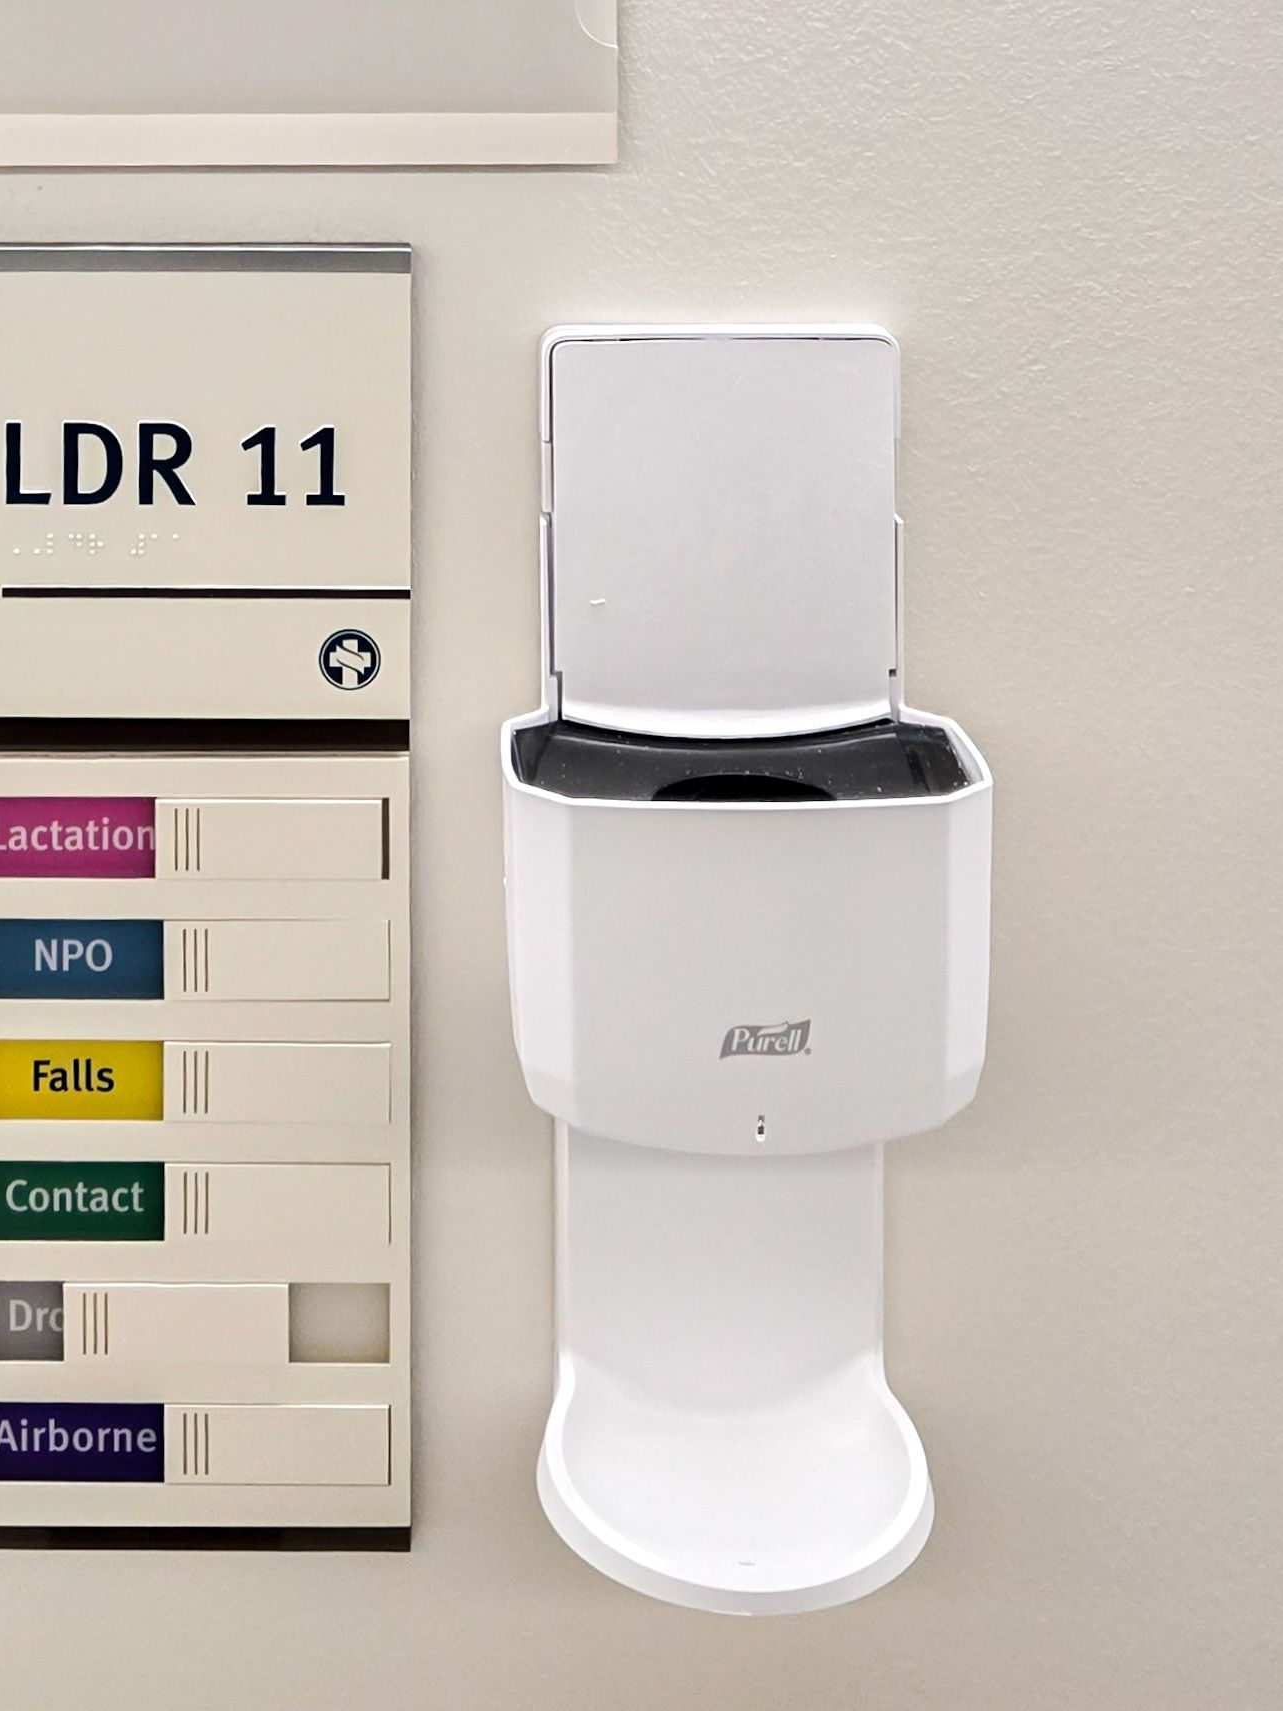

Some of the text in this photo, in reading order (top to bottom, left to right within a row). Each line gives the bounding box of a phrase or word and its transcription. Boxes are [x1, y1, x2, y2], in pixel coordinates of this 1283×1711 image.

[5, 421, 346, 506] LDR 11
[33, 939, 113, 972] NPO
[730, 1027, 803, 1052] Purell
[32, 1058, 115, 1092] Falls
[5, 1179, 145, 1213] Contact
